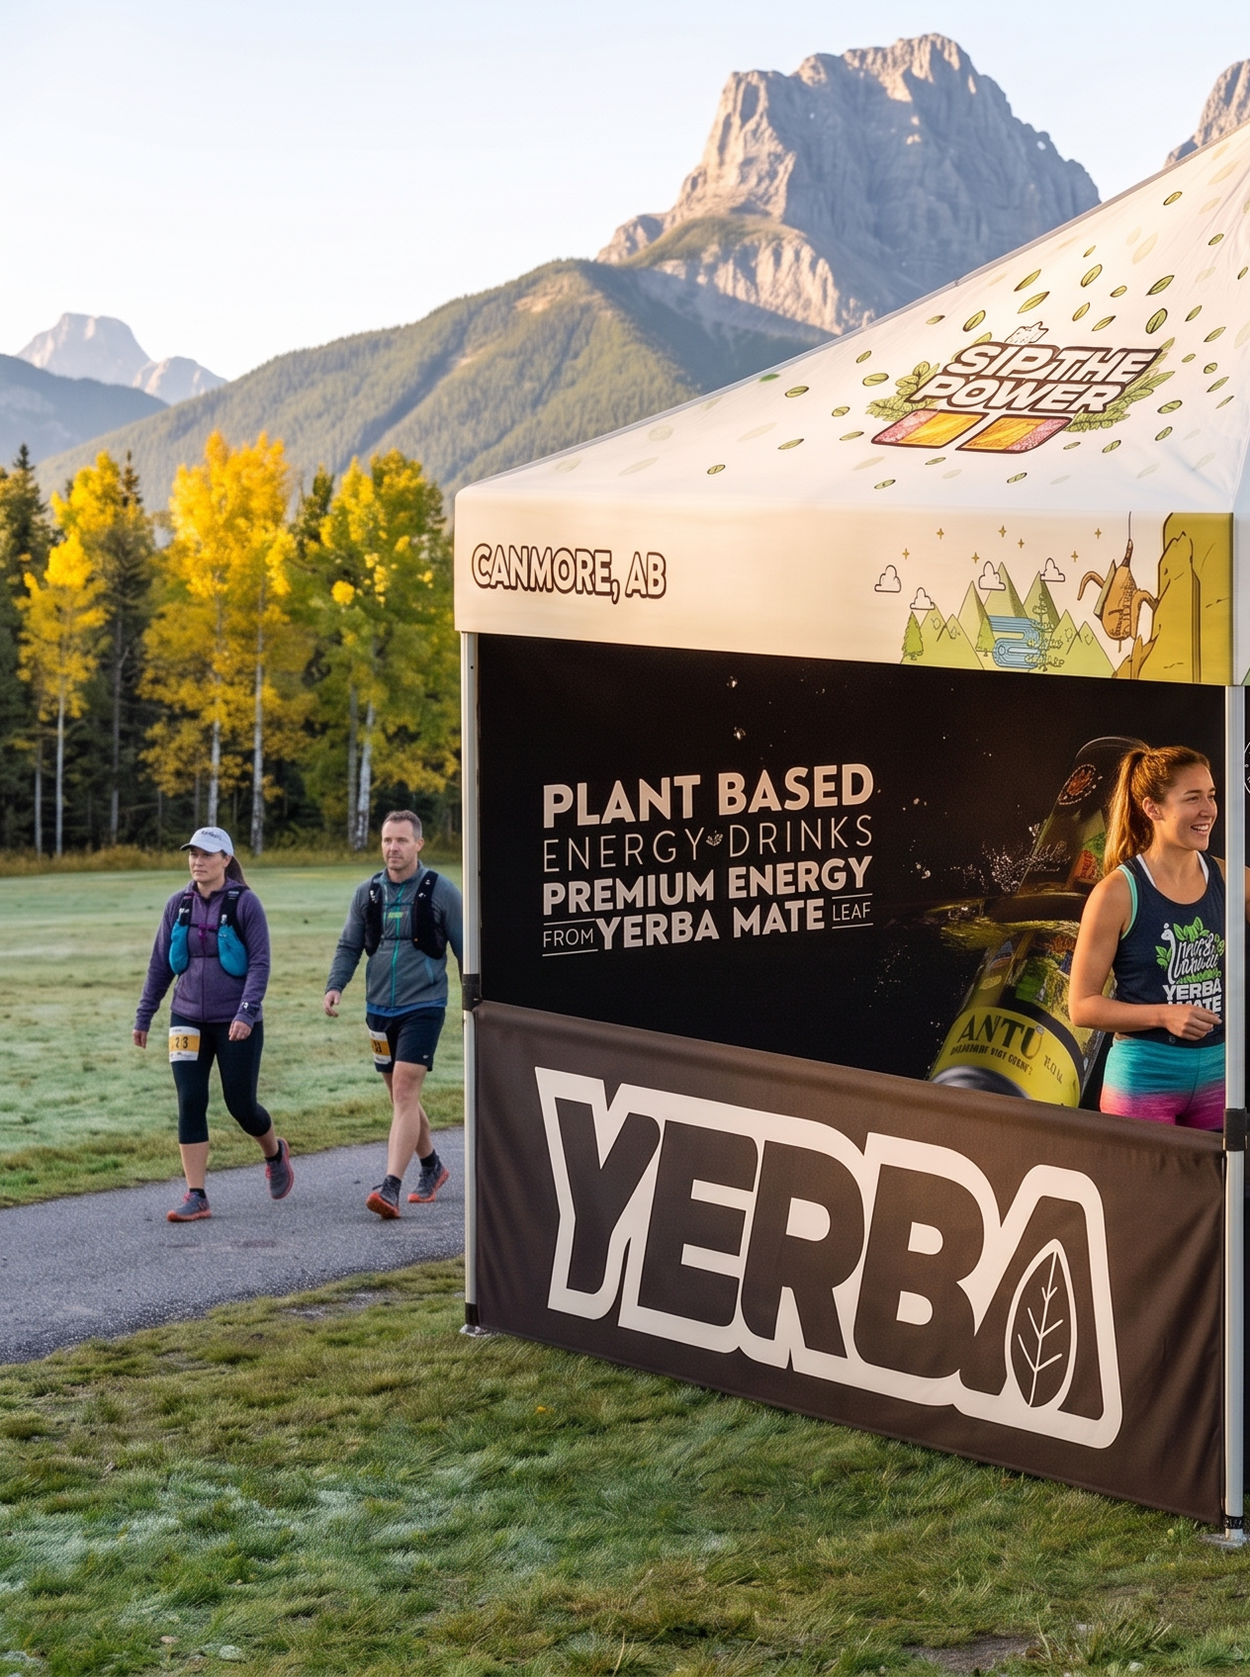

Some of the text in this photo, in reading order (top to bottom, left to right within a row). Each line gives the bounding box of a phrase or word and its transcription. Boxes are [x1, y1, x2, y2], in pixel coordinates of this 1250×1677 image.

[911, 374, 1125, 412] POWER
[945, 343, 1162, 384] SIP THE
[471, 542, 668, 605] CANMORE, AB
[543, 762, 874, 829] PLANT BASED
[543, 814, 873, 873] ENERGY DRINKS
[543, 855, 874, 916] PREMIUM ENERGY
[542, 897, 873, 951] FROM YERBA MATE LEAF
[1162, 978, 1222, 1001] YERBA
[537, 1068, 1123, 1449] YERBA
